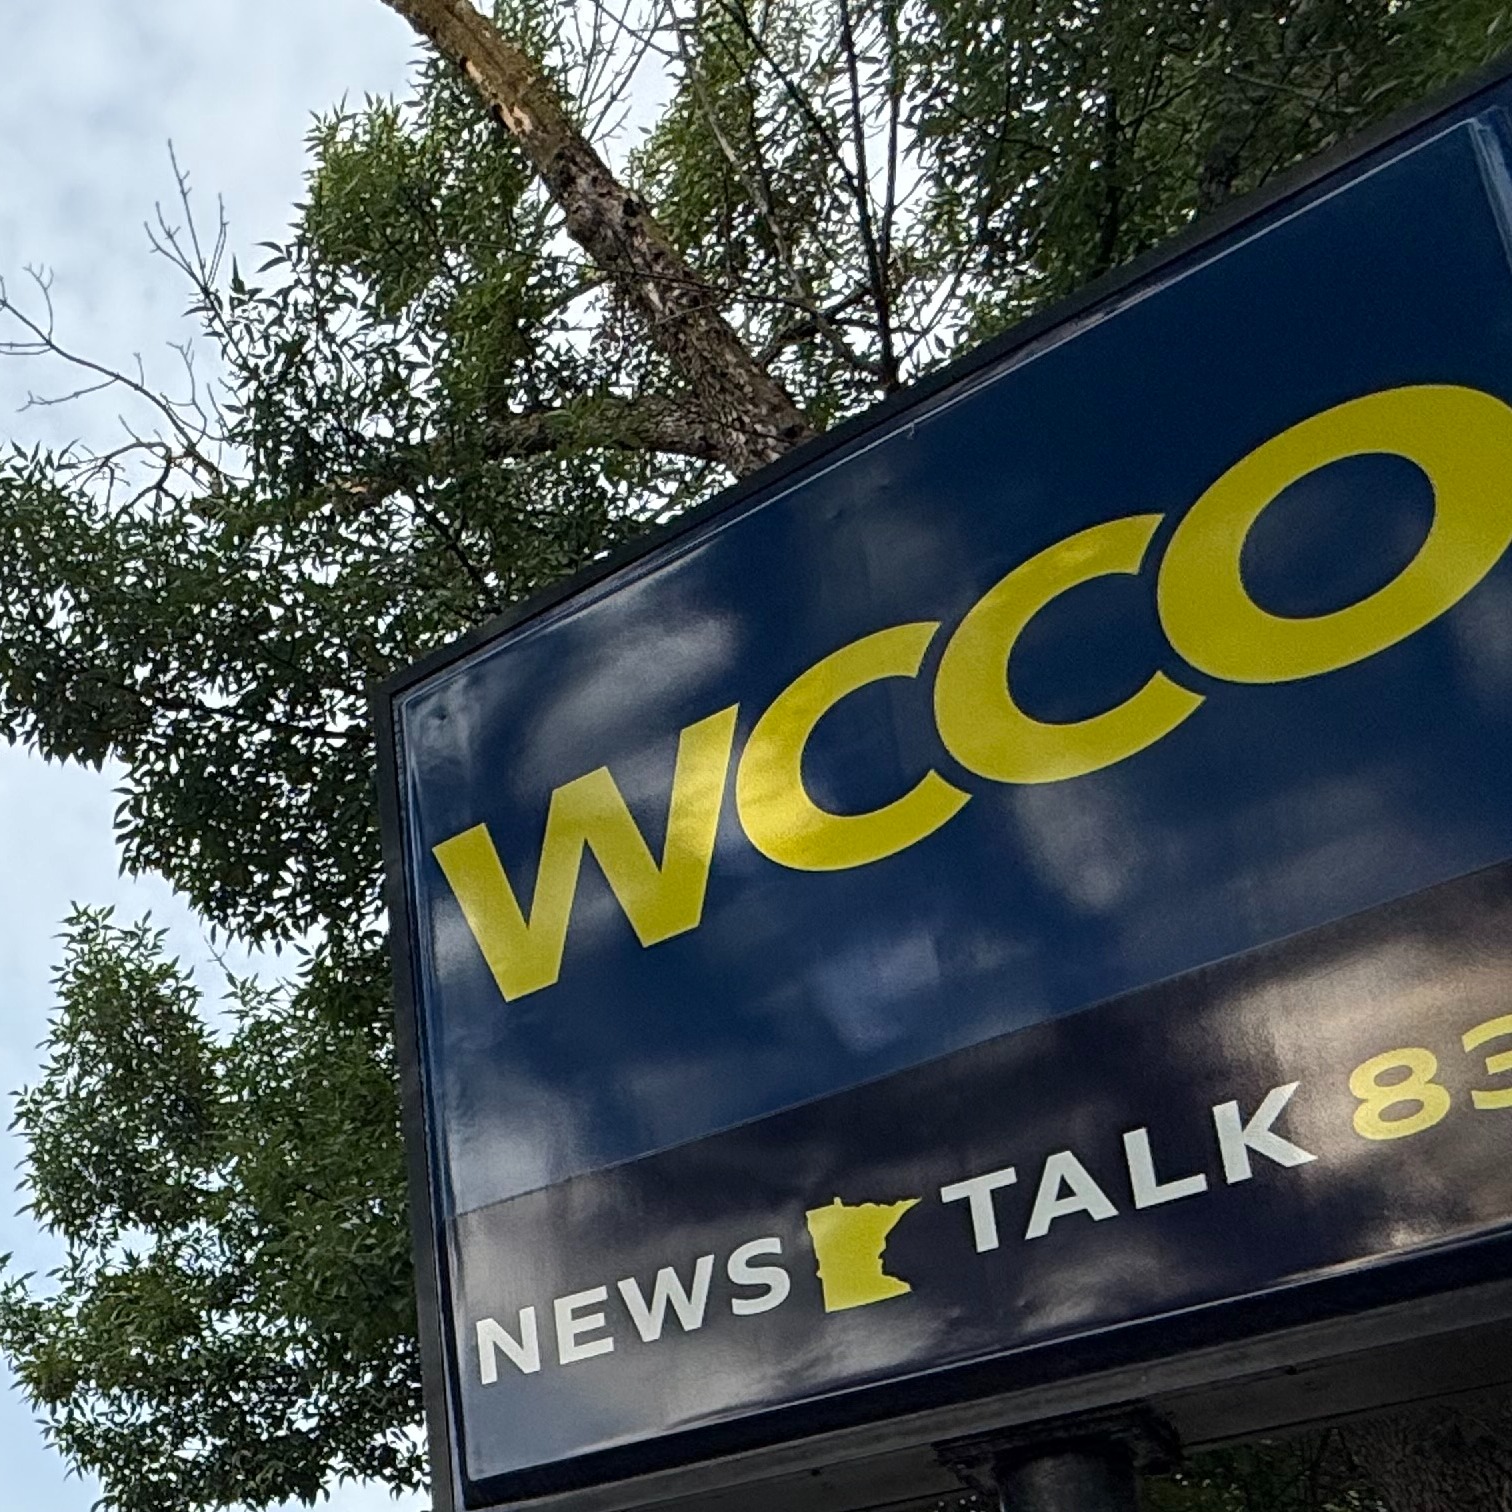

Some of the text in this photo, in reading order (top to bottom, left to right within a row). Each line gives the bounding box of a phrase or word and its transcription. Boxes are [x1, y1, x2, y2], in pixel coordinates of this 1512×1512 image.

[431, 383, 1512, 1002] WCCO
[475, 1237, 792, 1386] NEWS
[940, 1081, 1318, 1254] TALK
